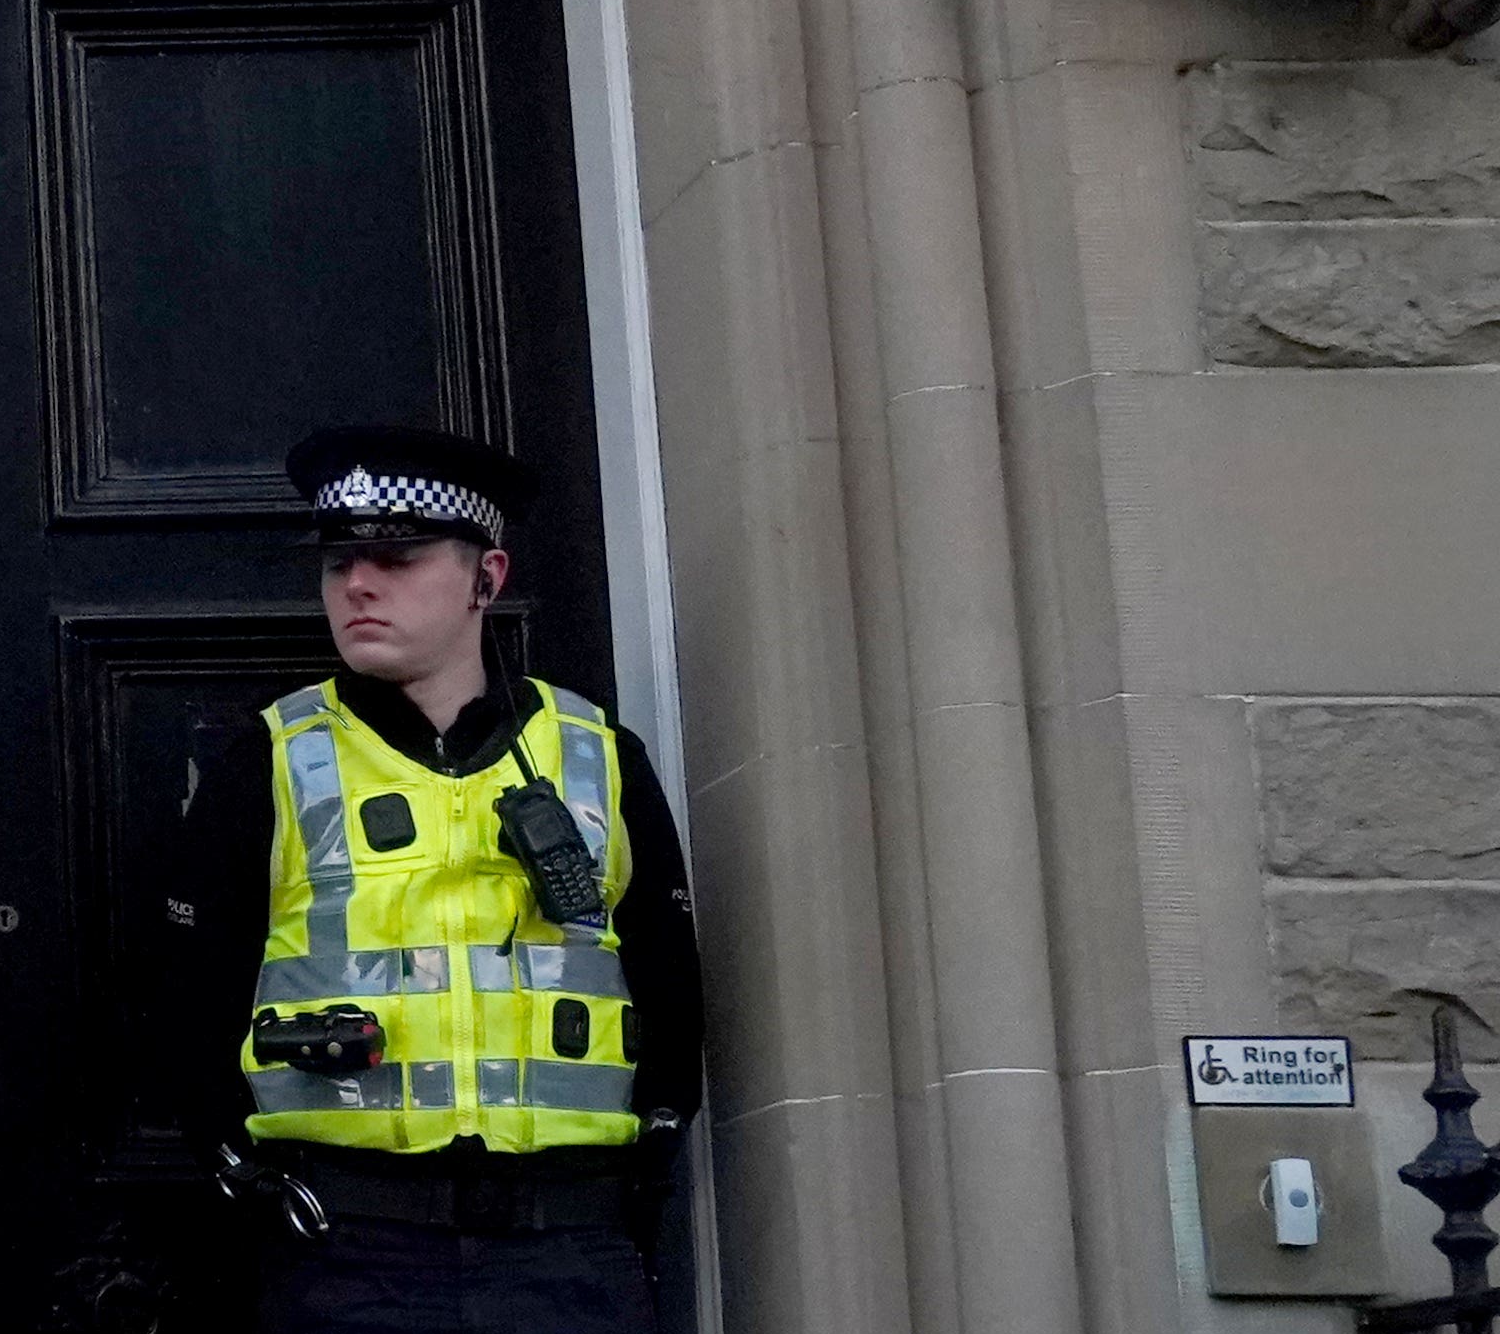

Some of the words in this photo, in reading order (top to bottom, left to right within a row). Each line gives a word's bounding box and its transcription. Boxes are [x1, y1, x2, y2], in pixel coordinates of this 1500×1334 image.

[1243, 1046, 1297, 1067] Ring
[1304, 1046, 1339, 1063] for
[1242, 1069, 1343, 1086] attention
